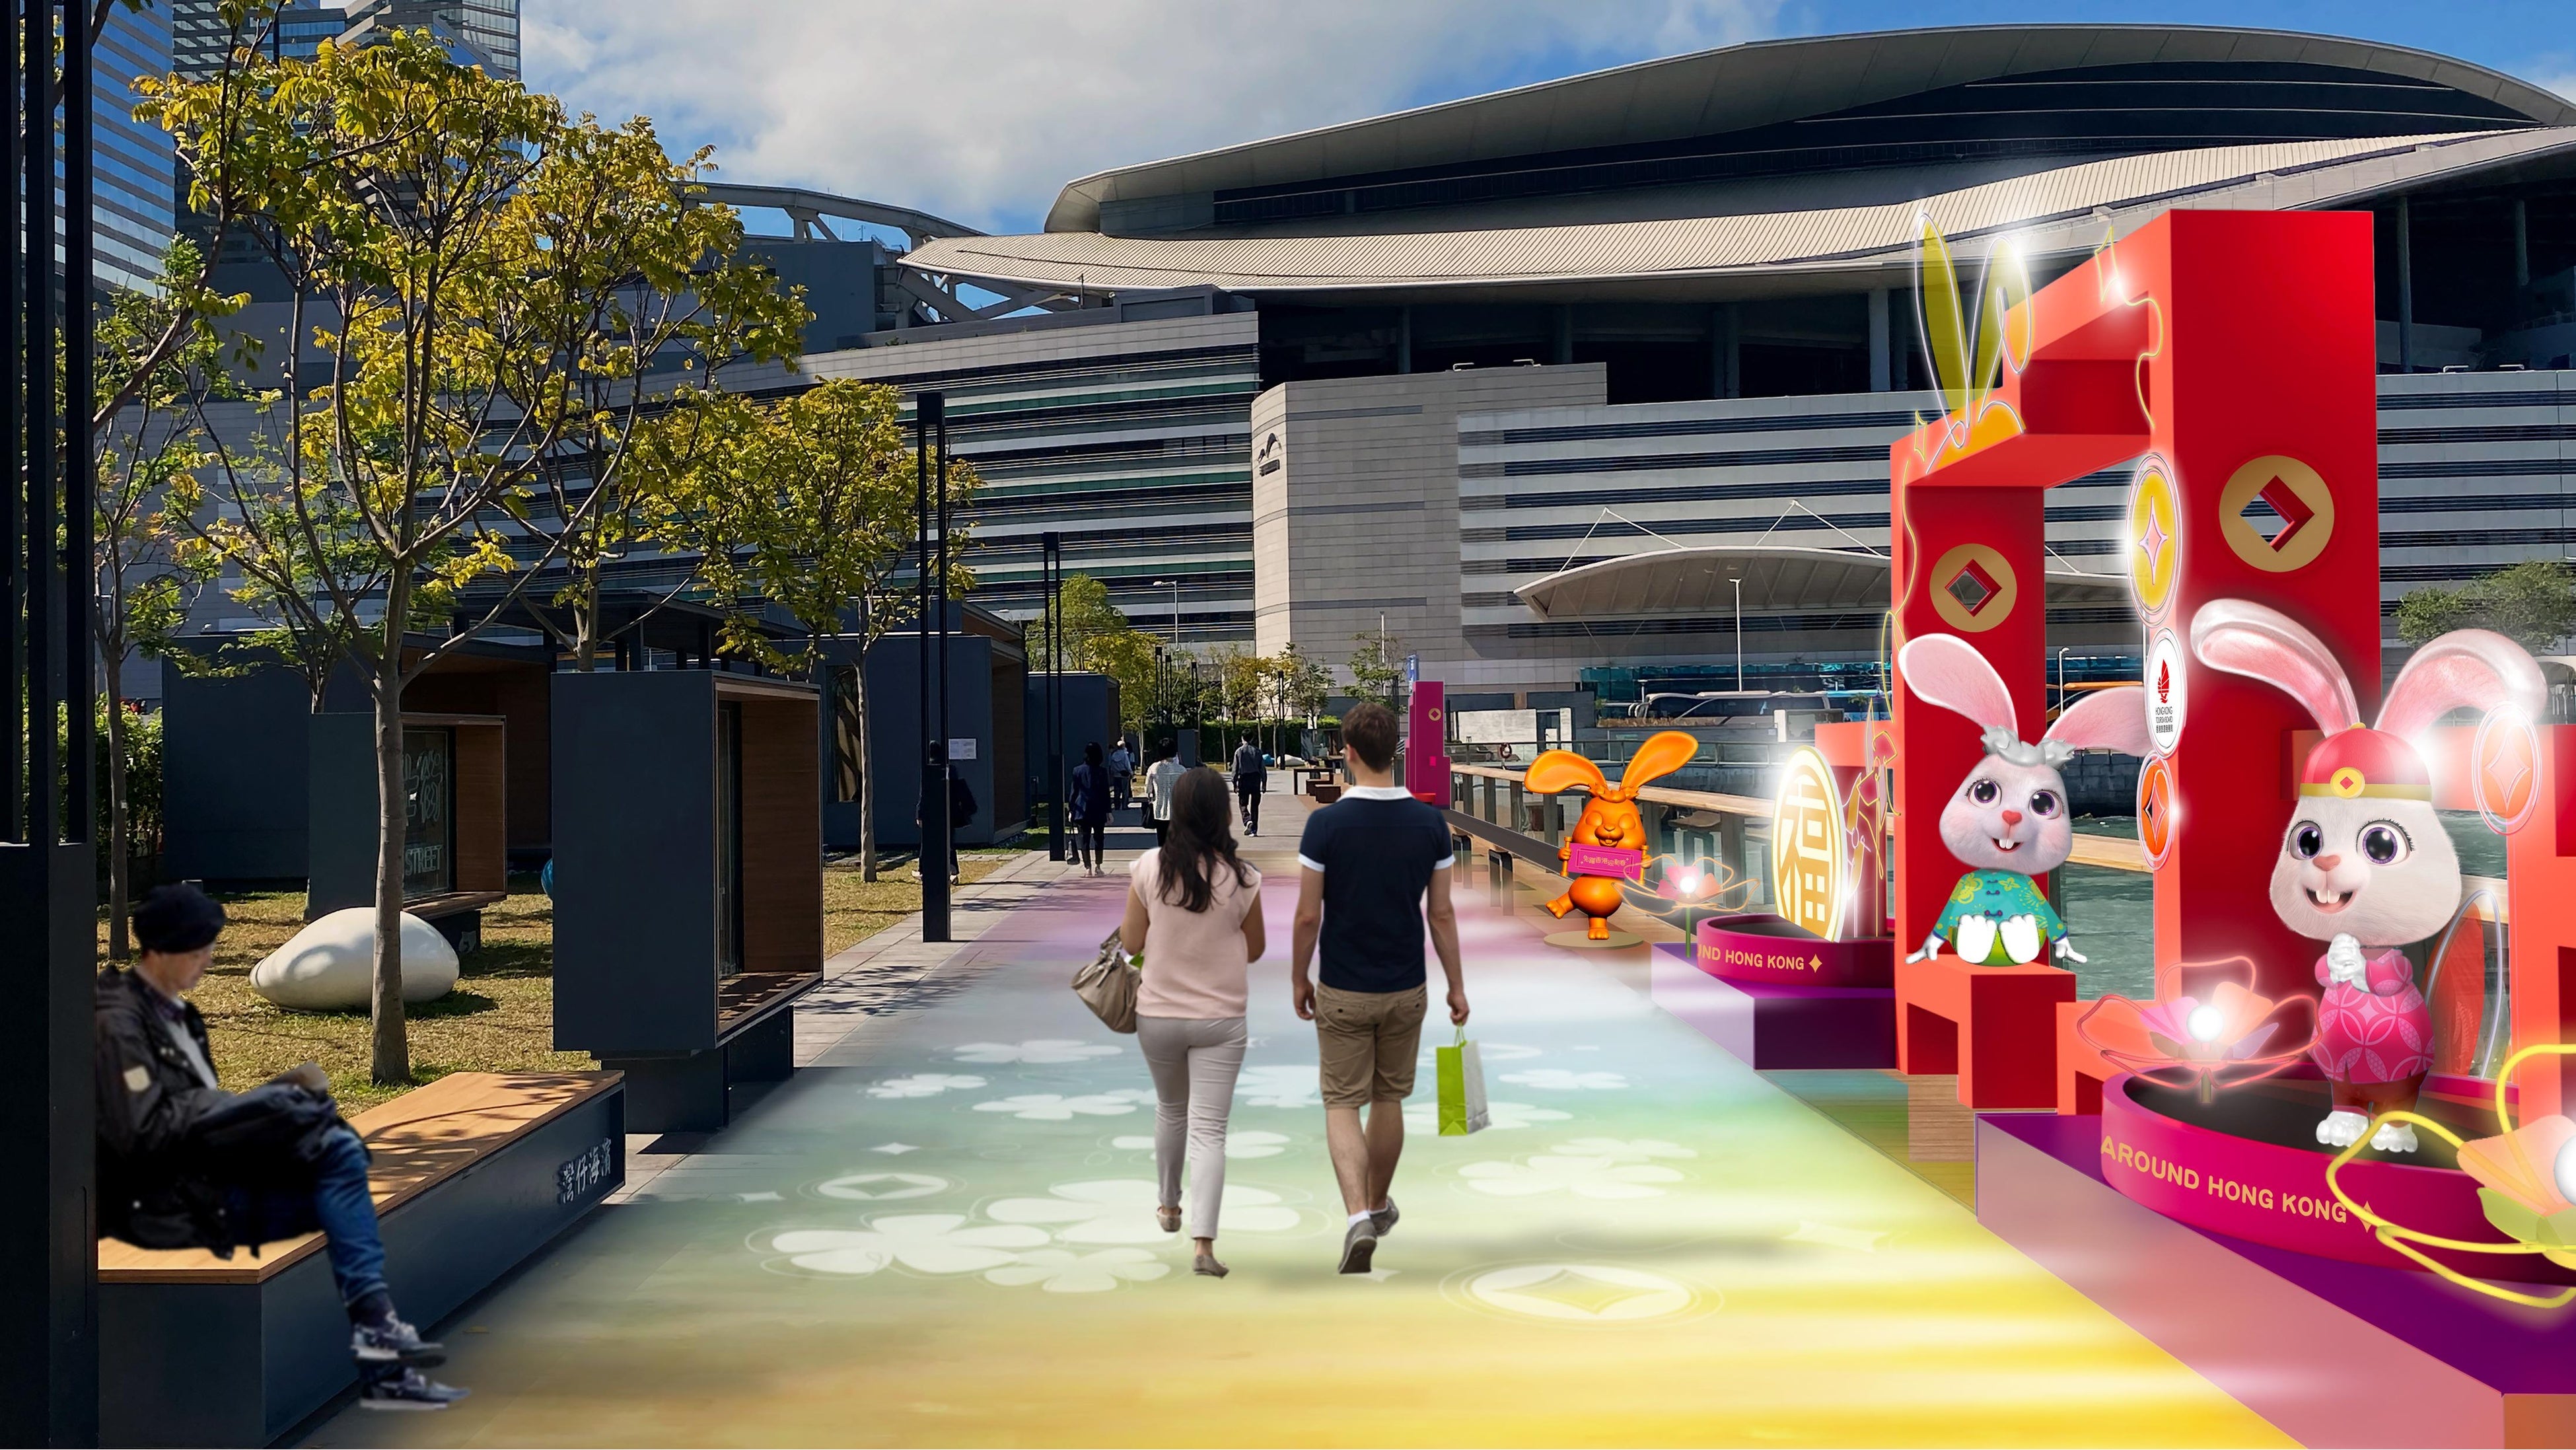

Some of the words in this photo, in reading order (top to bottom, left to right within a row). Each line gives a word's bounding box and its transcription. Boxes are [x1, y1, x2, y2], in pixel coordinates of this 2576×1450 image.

[405, 845, 443, 876] STREET
[1779, 774, 1833, 938] 福
[1725, 949, 1762, 968] HONG
[1767, 955, 1804, 970] KONG
[563, 1138, 611, 1203] 灣仔海濱
[2101, 1136, 2199, 1189] AROUND
[2208, 1175, 2273, 1210] HONG
[2282, 1193, 2347, 1223] KONG
